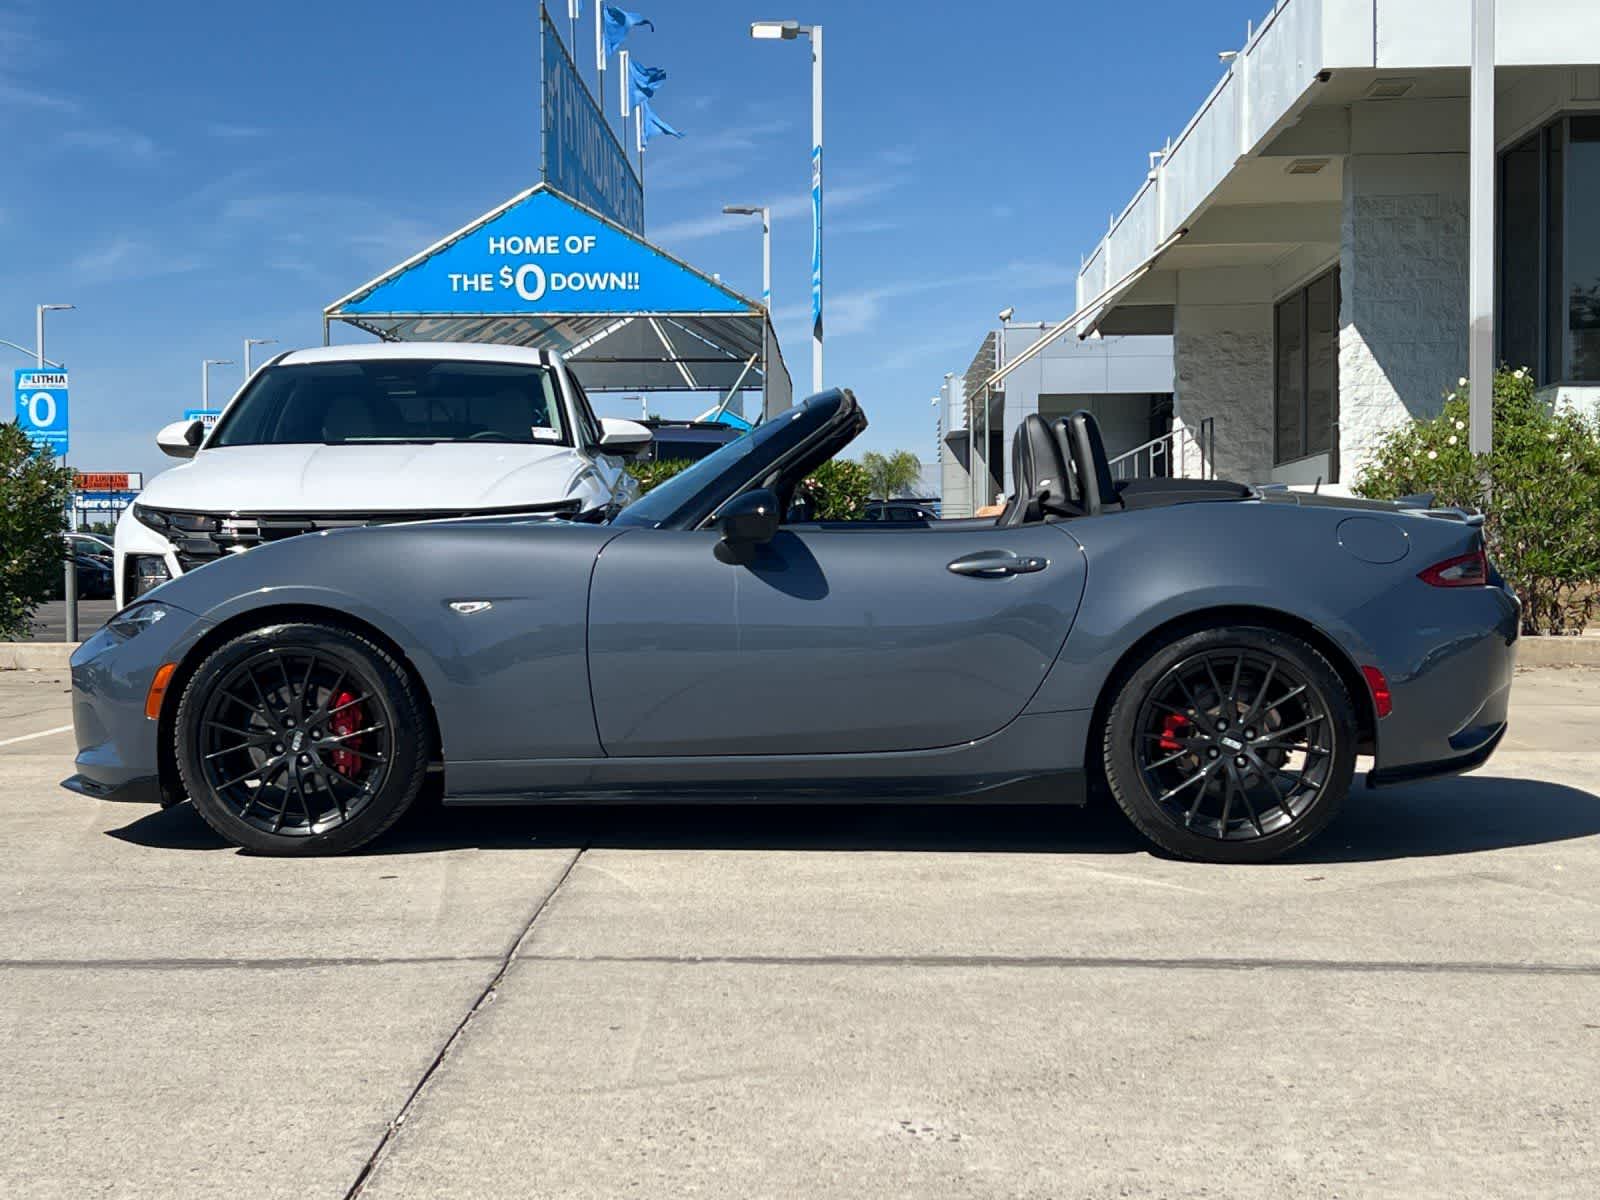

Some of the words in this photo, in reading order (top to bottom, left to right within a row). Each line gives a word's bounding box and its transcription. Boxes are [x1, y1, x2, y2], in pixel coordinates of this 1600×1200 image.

[489, 236, 560, 255] HOME
[565, 236, 596, 254] OF
[448, 274, 494, 292] THE
[499, 263, 546, 301] $0
[551, 272, 640, 291] DOWN!!
[32, 375, 66, 384] LITHIA
[20, 391, 56, 428] $0
